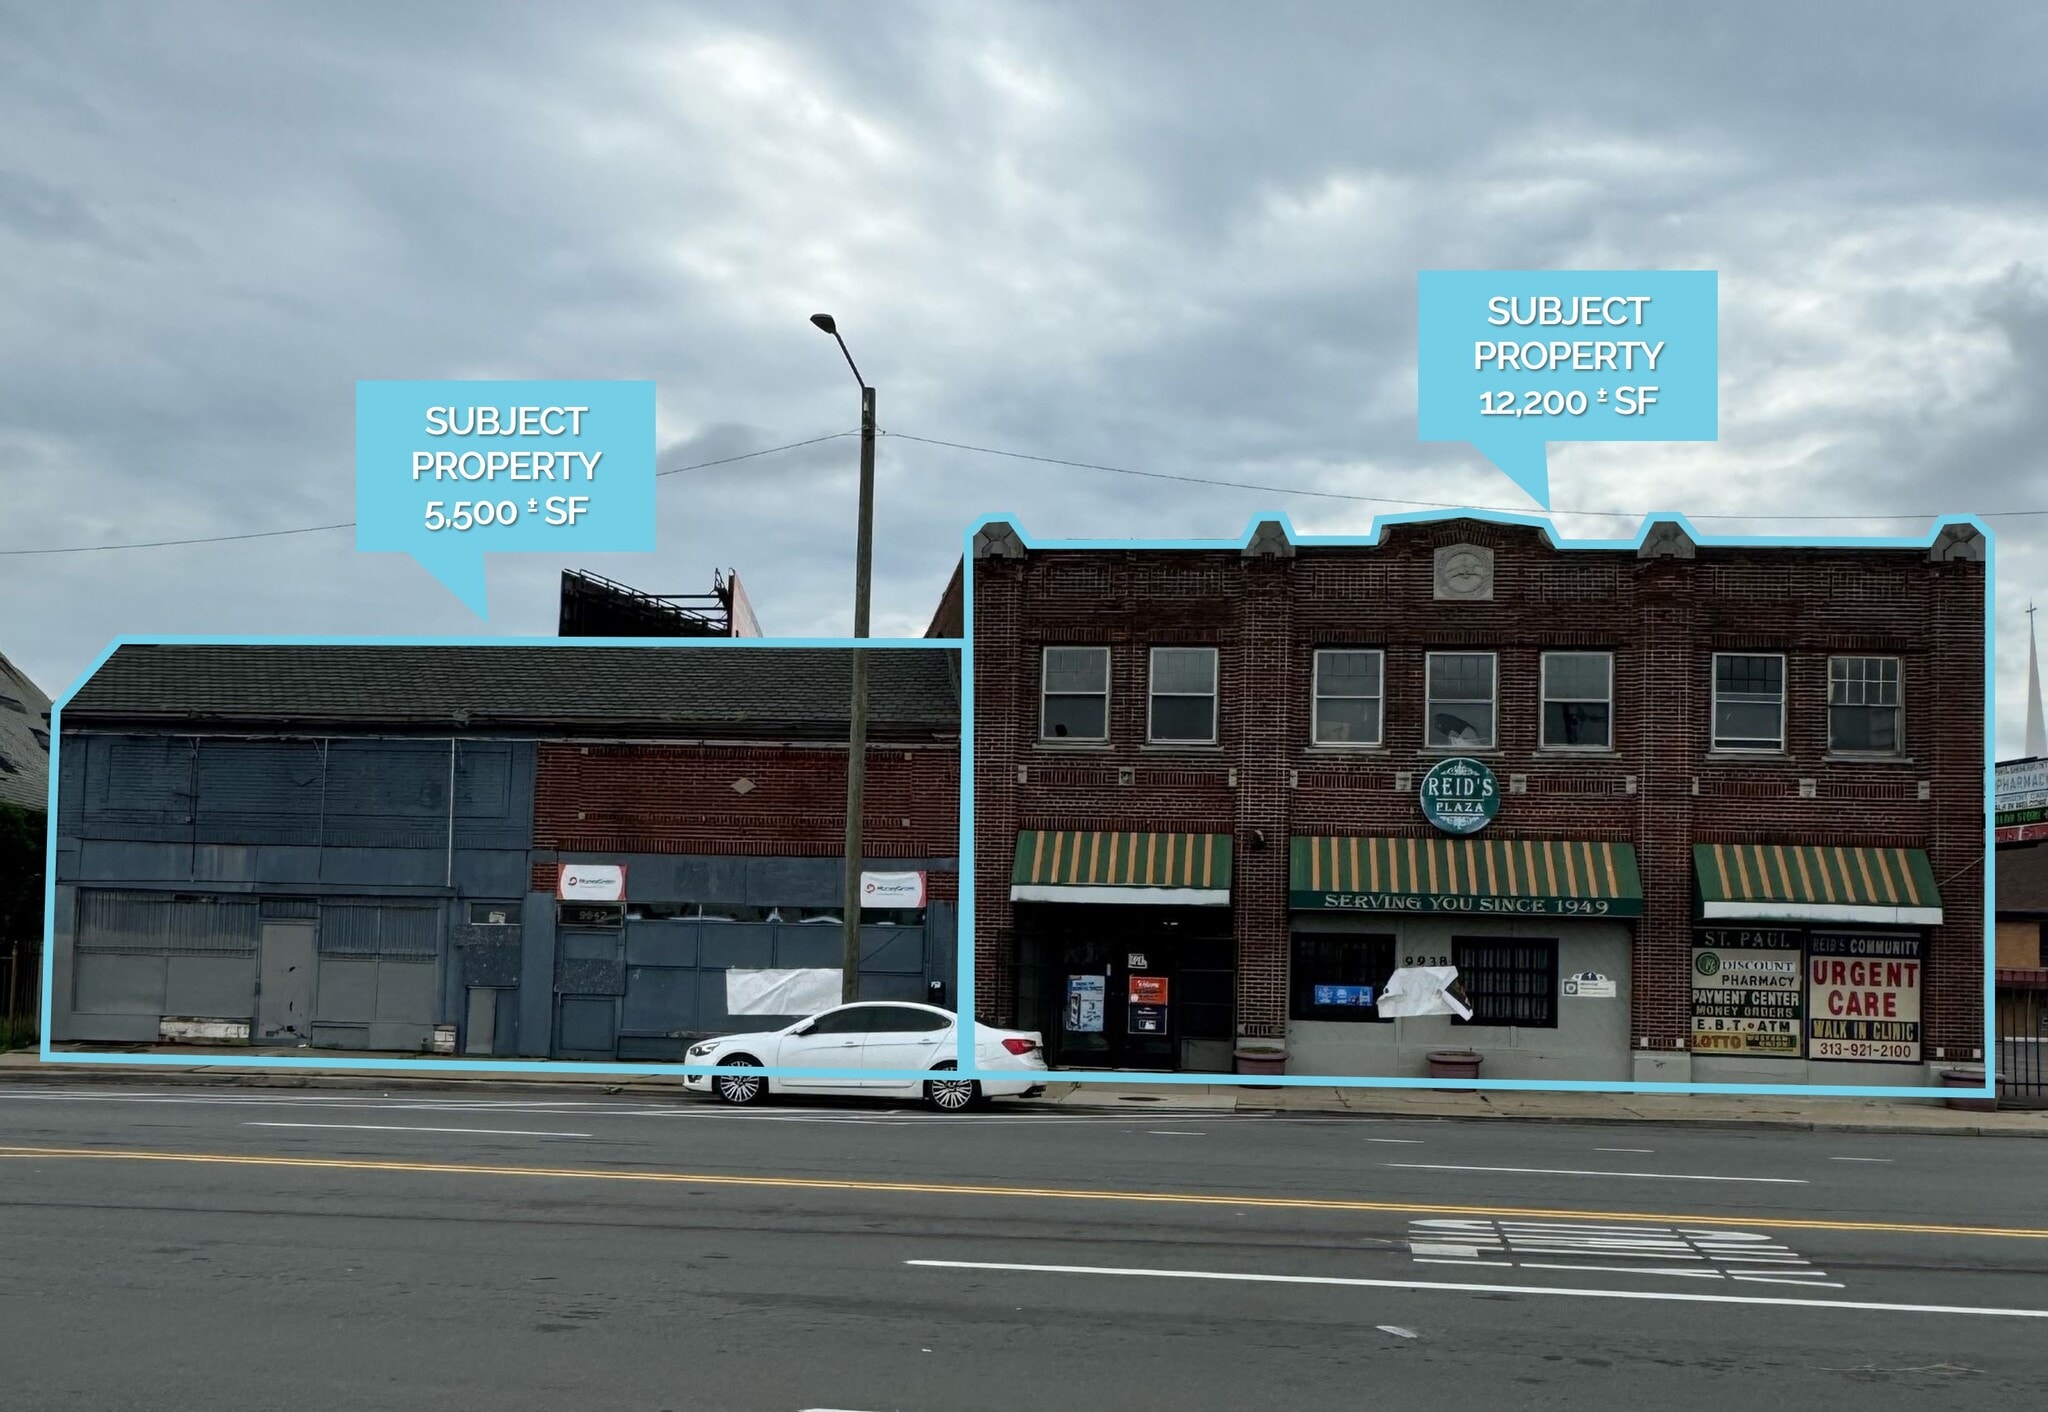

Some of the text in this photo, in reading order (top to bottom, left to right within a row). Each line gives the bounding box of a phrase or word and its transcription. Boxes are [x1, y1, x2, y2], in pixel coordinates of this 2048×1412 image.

[1428, 777, 1493, 796] REID'S
[1436, 802, 1484, 813] PLAZA
[1324, 894, 1609, 915] SERVING YOU SINCE 1949
[1704, 931, 1791, 948] ST. PAUL
[1813, 937, 1919, 955] REID'S COMMUNITY
[1405, 956, 1448, 967] 9938
[1722, 961, 1793, 972] DISCOUNT
[1722, 975, 1795, 987] PHARMACY
[1813, 960, 1919, 988] URGENT
[1692, 989, 1799, 1006] PAYMENT CENTER
[1827, 990, 1897, 1018] CARE
[1696, 1005, 1793, 1018] MONEY ORDERS
[1757, 1021, 1790, 1033] ATM
[1813, 1021, 1914, 1041] WALK IN CLINIC
[1692, 1035, 1742, 1049] LOTTO
[1820, 1042, 1911, 1058] 313-921-2100
